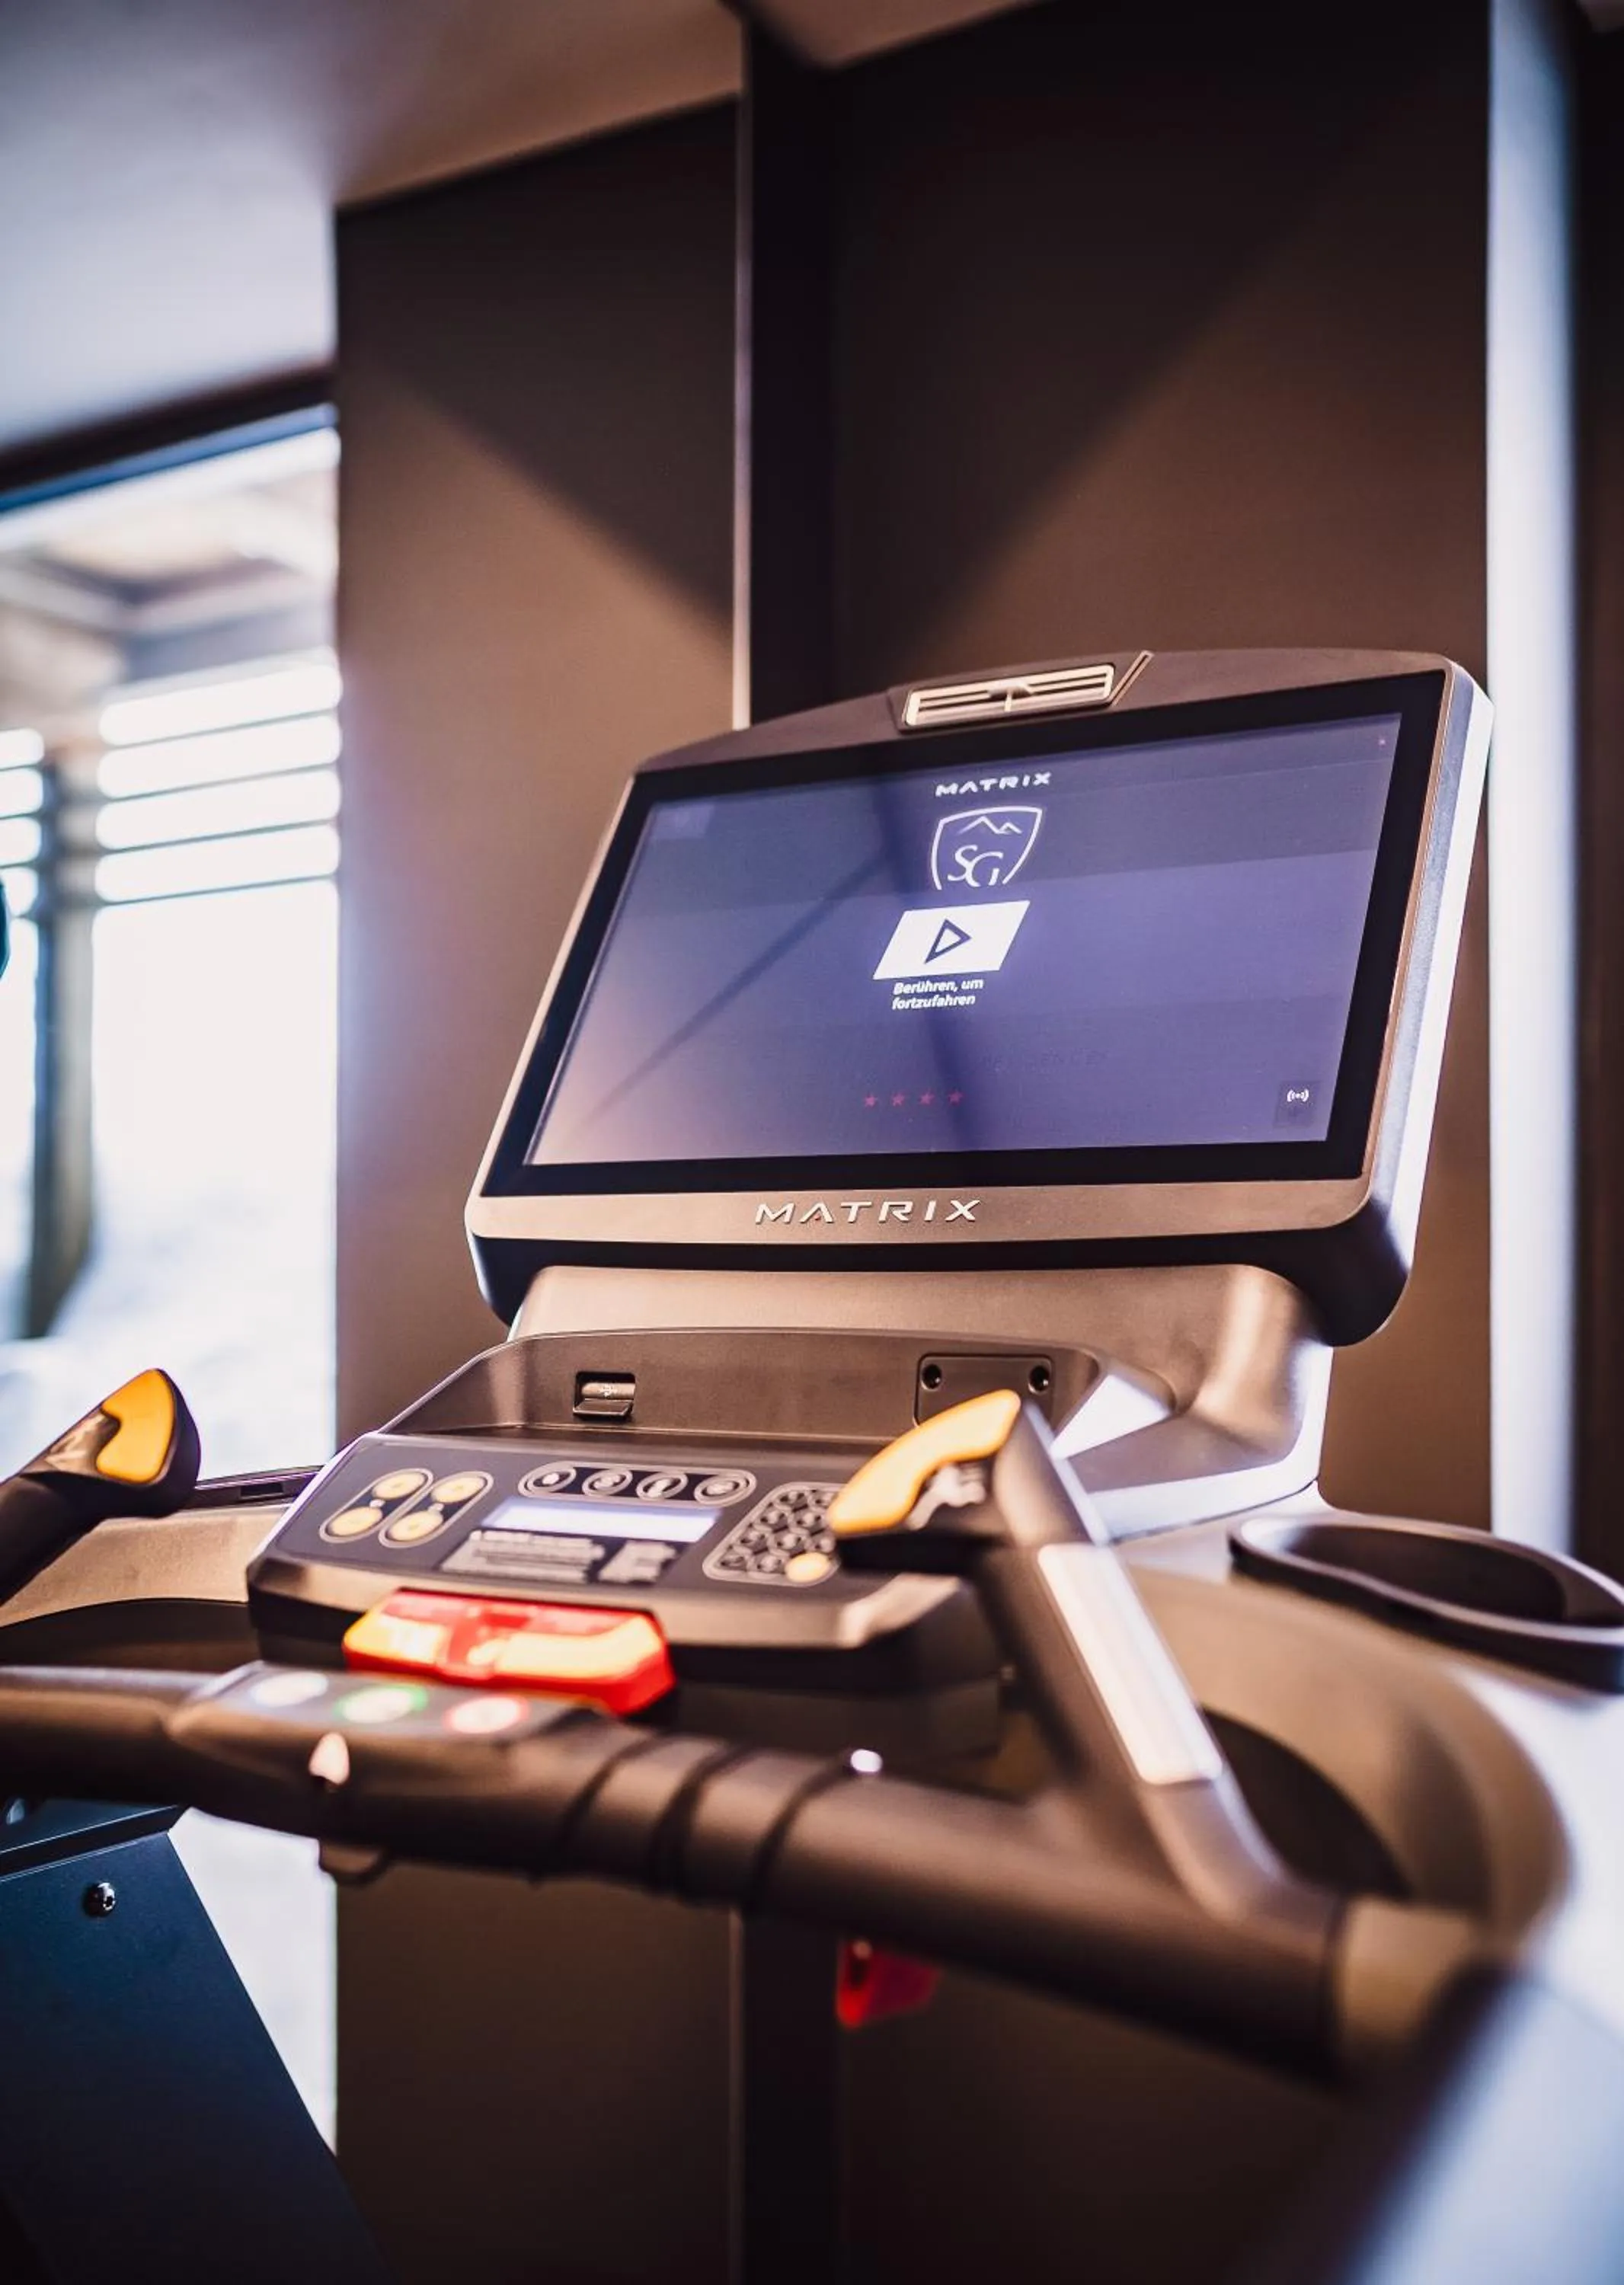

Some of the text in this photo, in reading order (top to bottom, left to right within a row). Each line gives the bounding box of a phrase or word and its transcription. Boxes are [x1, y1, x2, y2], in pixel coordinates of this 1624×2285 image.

[935, 772, 1051, 797] MATRIX
[893, 978, 983, 995] Berühren, um
[891, 993, 976, 1010] fortzufahren
[755, 1200, 981, 1225] MATRIX
